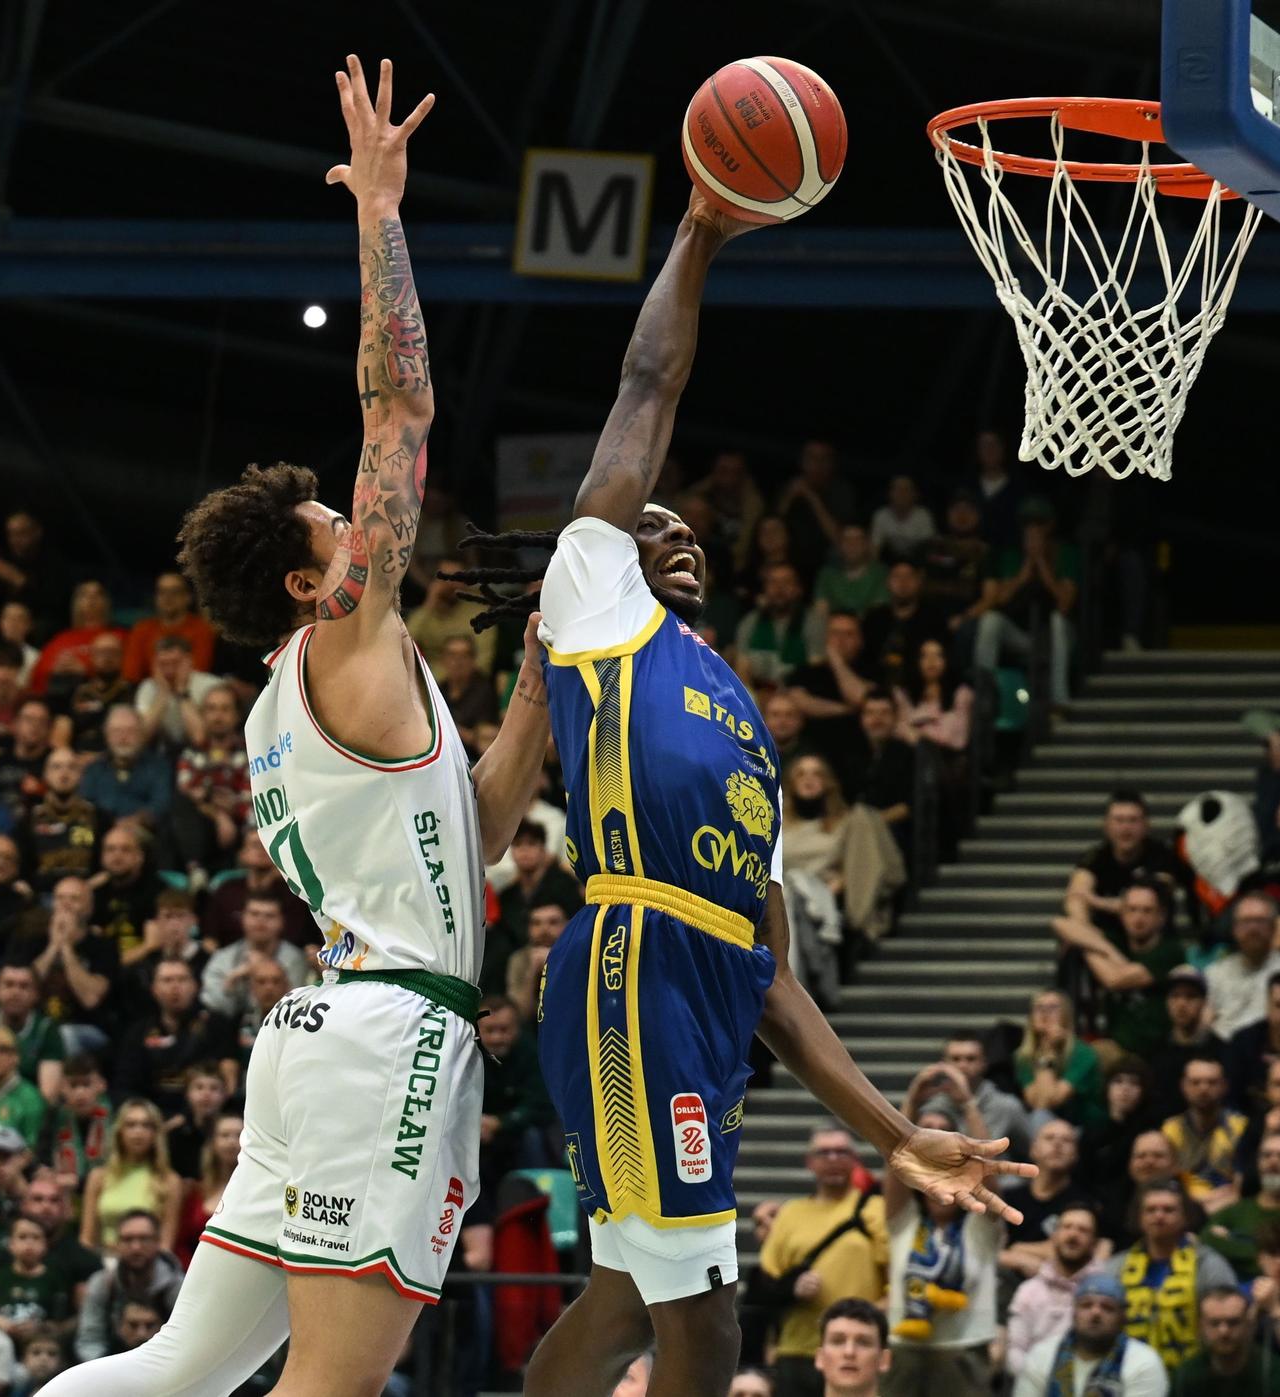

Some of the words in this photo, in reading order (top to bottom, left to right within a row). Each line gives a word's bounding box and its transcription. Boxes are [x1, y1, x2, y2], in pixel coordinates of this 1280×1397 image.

[734, 96, 760, 130] FIBA
[698, 111, 740, 173] molten
[531, 169, 636, 256] M
[602, 925, 626, 991] STAL
[675, 1106, 703, 1115] ORLEN
[681, 1158, 708, 1167] Basket
[687, 1167, 705, 1176] Liga
[303, 1191, 356, 1212] DOLNY
[302, 1202, 350, 1227] ŚLĄSK
